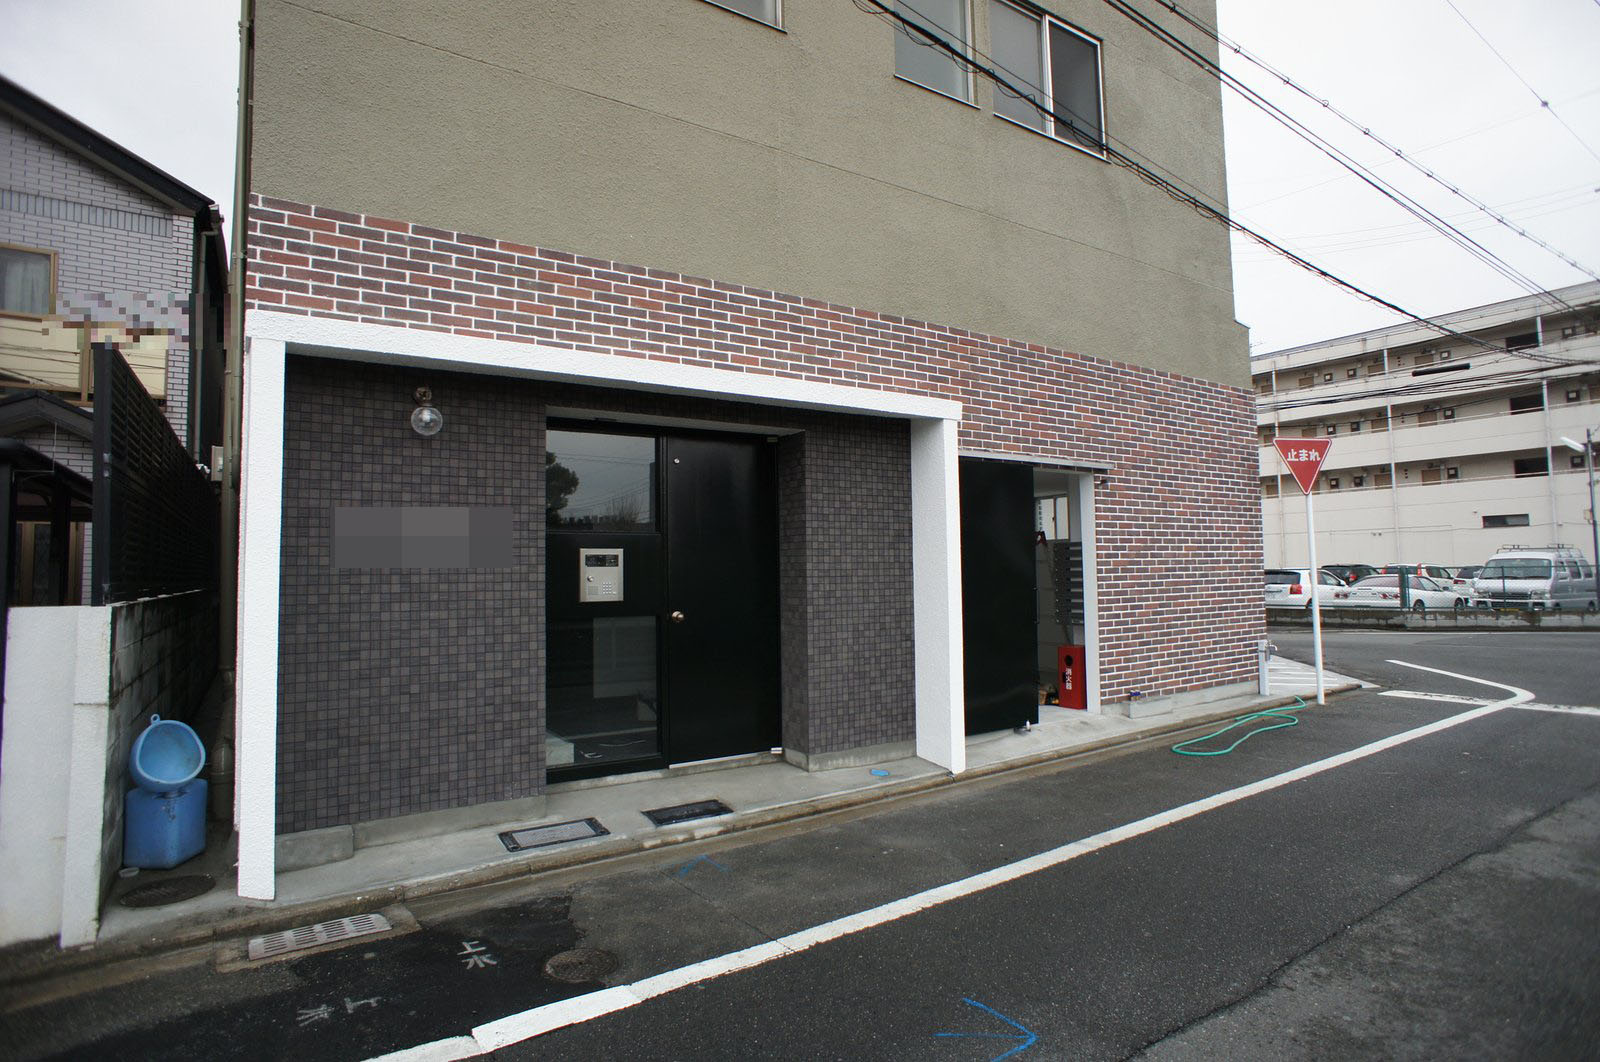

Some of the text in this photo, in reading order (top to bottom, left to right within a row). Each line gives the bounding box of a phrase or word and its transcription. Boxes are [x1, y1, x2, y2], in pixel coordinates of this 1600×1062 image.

[1287, 448, 1321, 462] 止まれ
[1065, 667, 1073, 690] 消火器
